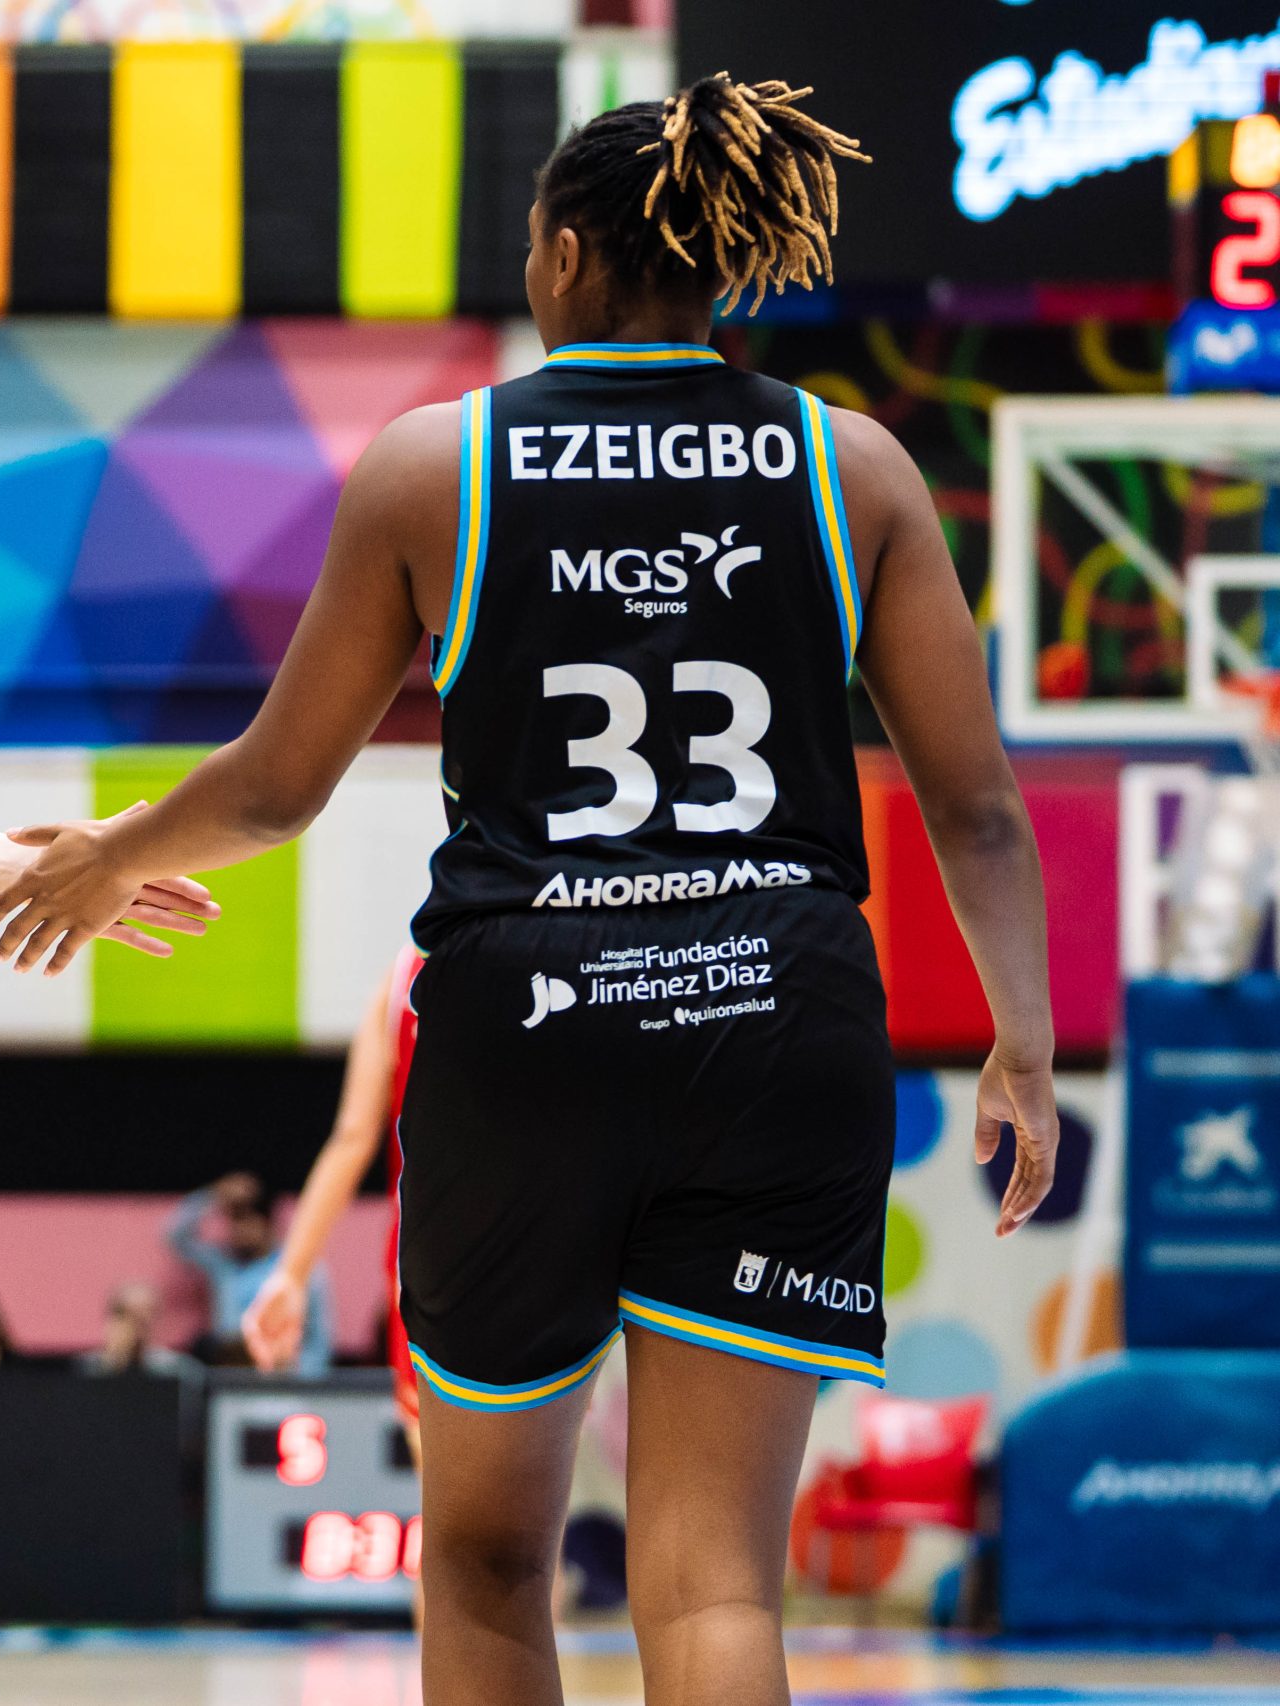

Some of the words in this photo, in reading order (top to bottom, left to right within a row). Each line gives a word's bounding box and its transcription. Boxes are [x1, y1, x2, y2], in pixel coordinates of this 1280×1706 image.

[508, 424, 797, 480] EZEIGBO
[550, 549, 689, 594] MGS
[624, 598, 688, 619] Seguros
[543, 660, 778, 842] 33
[601, 948, 643, 960] Hospital
[645, 934, 769, 969] Fundación
[587, 974, 700, 1005] Jiménez
[706, 962, 773, 992] Díaz
[640, 1019, 671, 1031] Grupo
[781, 1267, 876, 1314] MADID
